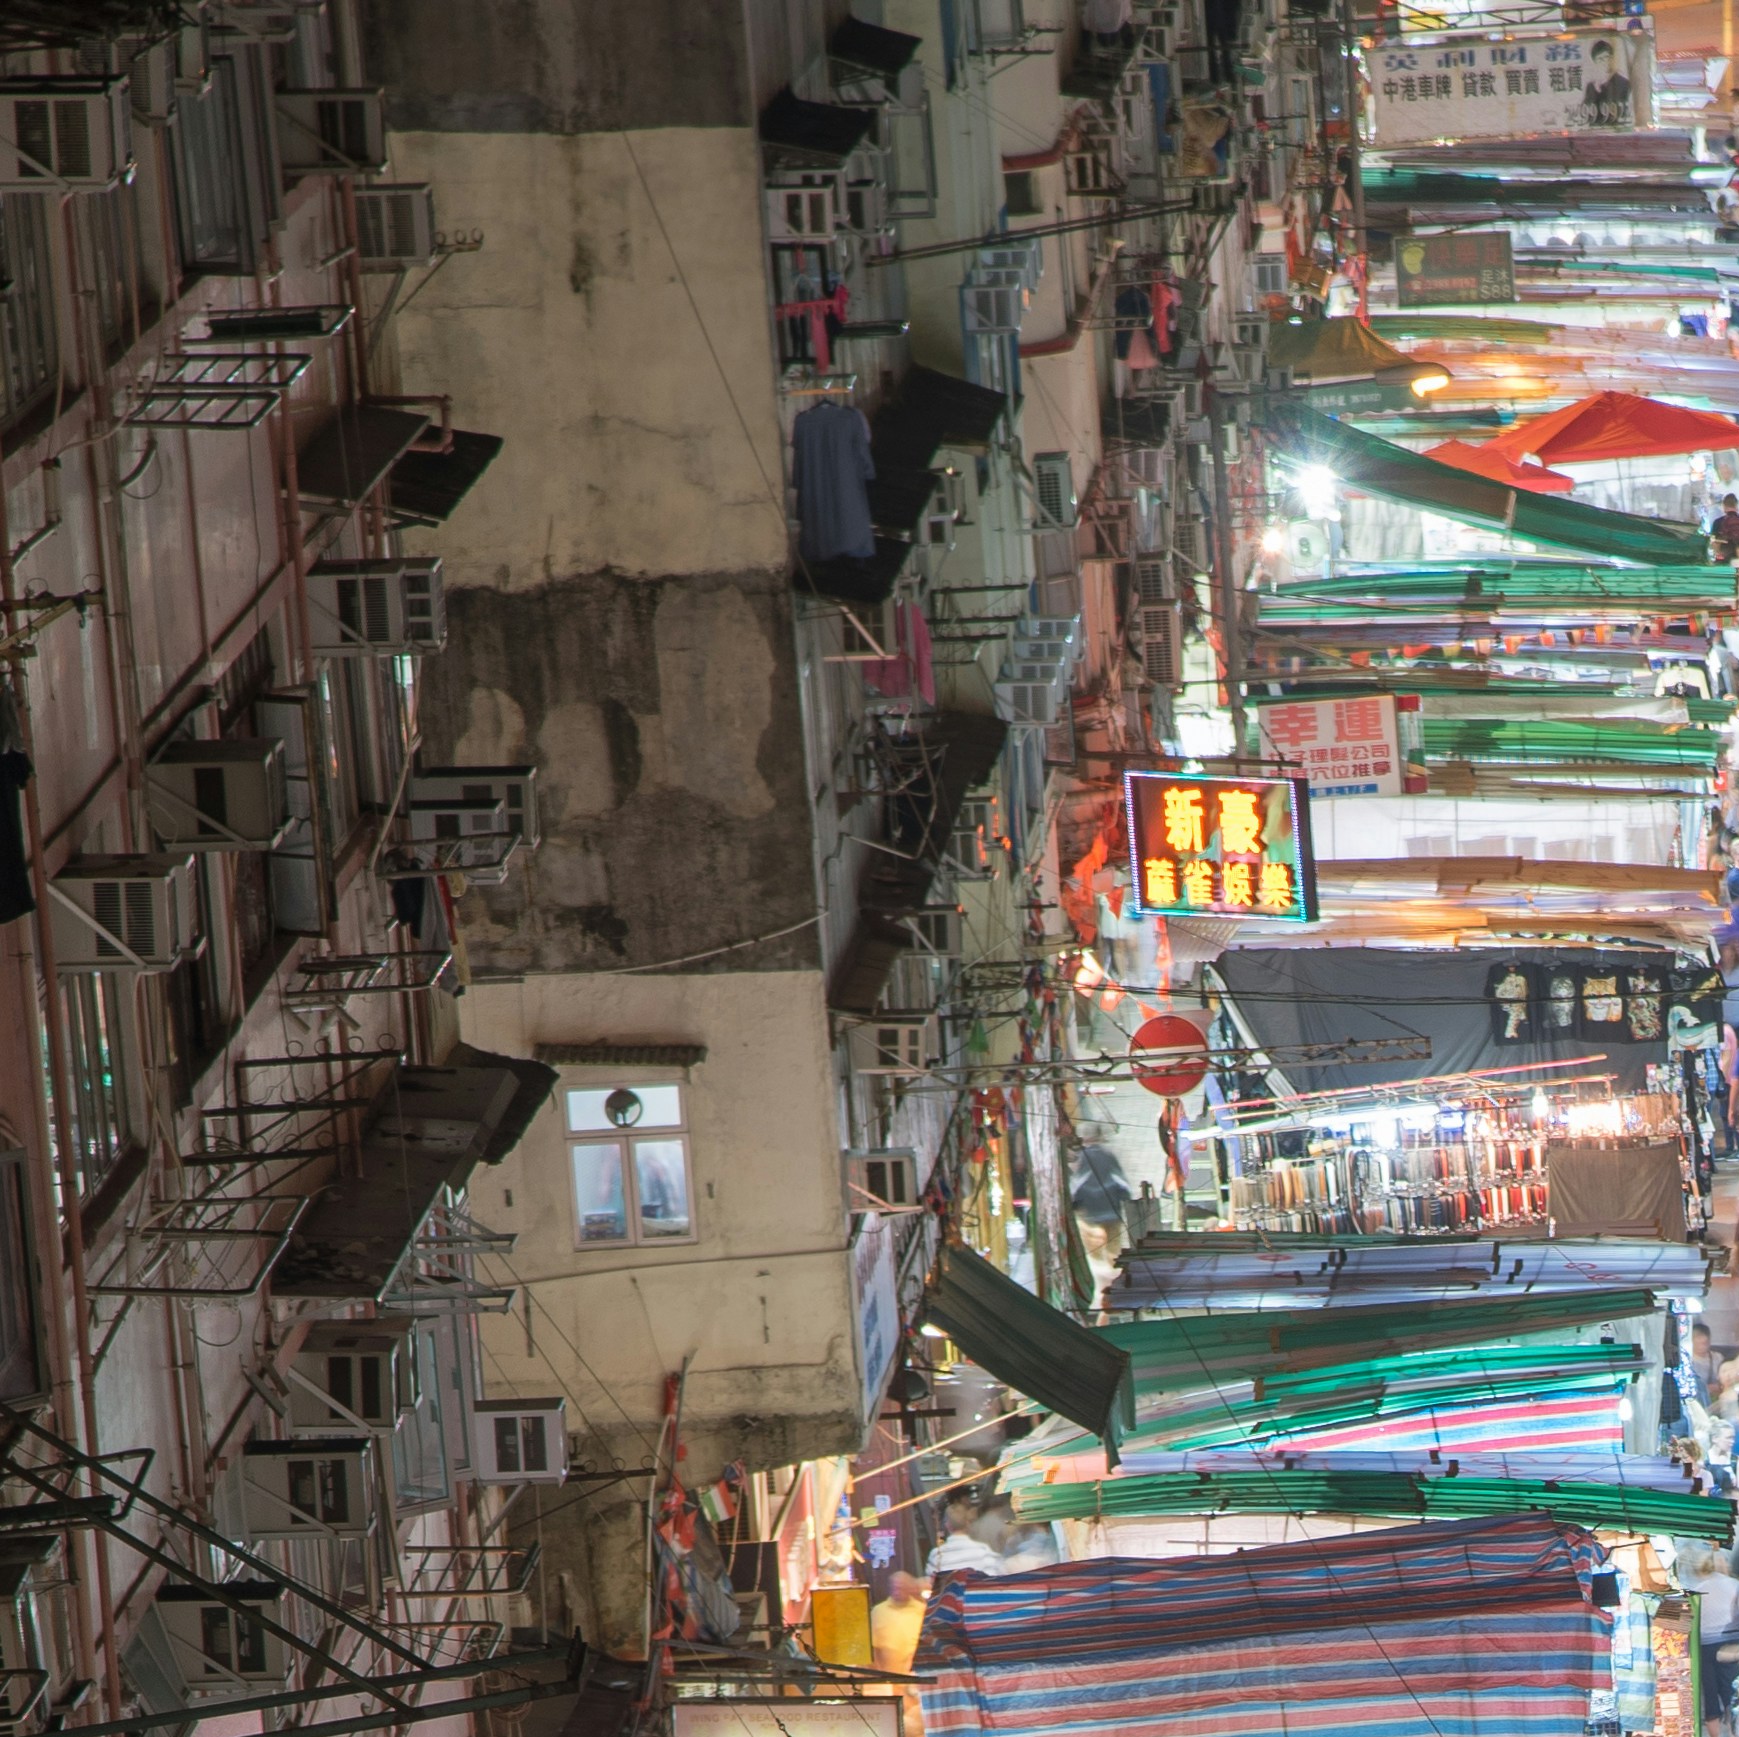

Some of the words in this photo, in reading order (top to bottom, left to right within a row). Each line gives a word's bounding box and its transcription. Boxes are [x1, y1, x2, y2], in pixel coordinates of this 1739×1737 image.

[1462, 71, 1496, 98] 貸款
[1506, 68, 1540, 95] 買賣
[1549, 65, 1584, 92] 租賃
[1269, 700, 1383, 747] 幸運
[1163, 787, 1262, 854] 新豪
[806, 1710, 882, 1723] RESTAURANT
